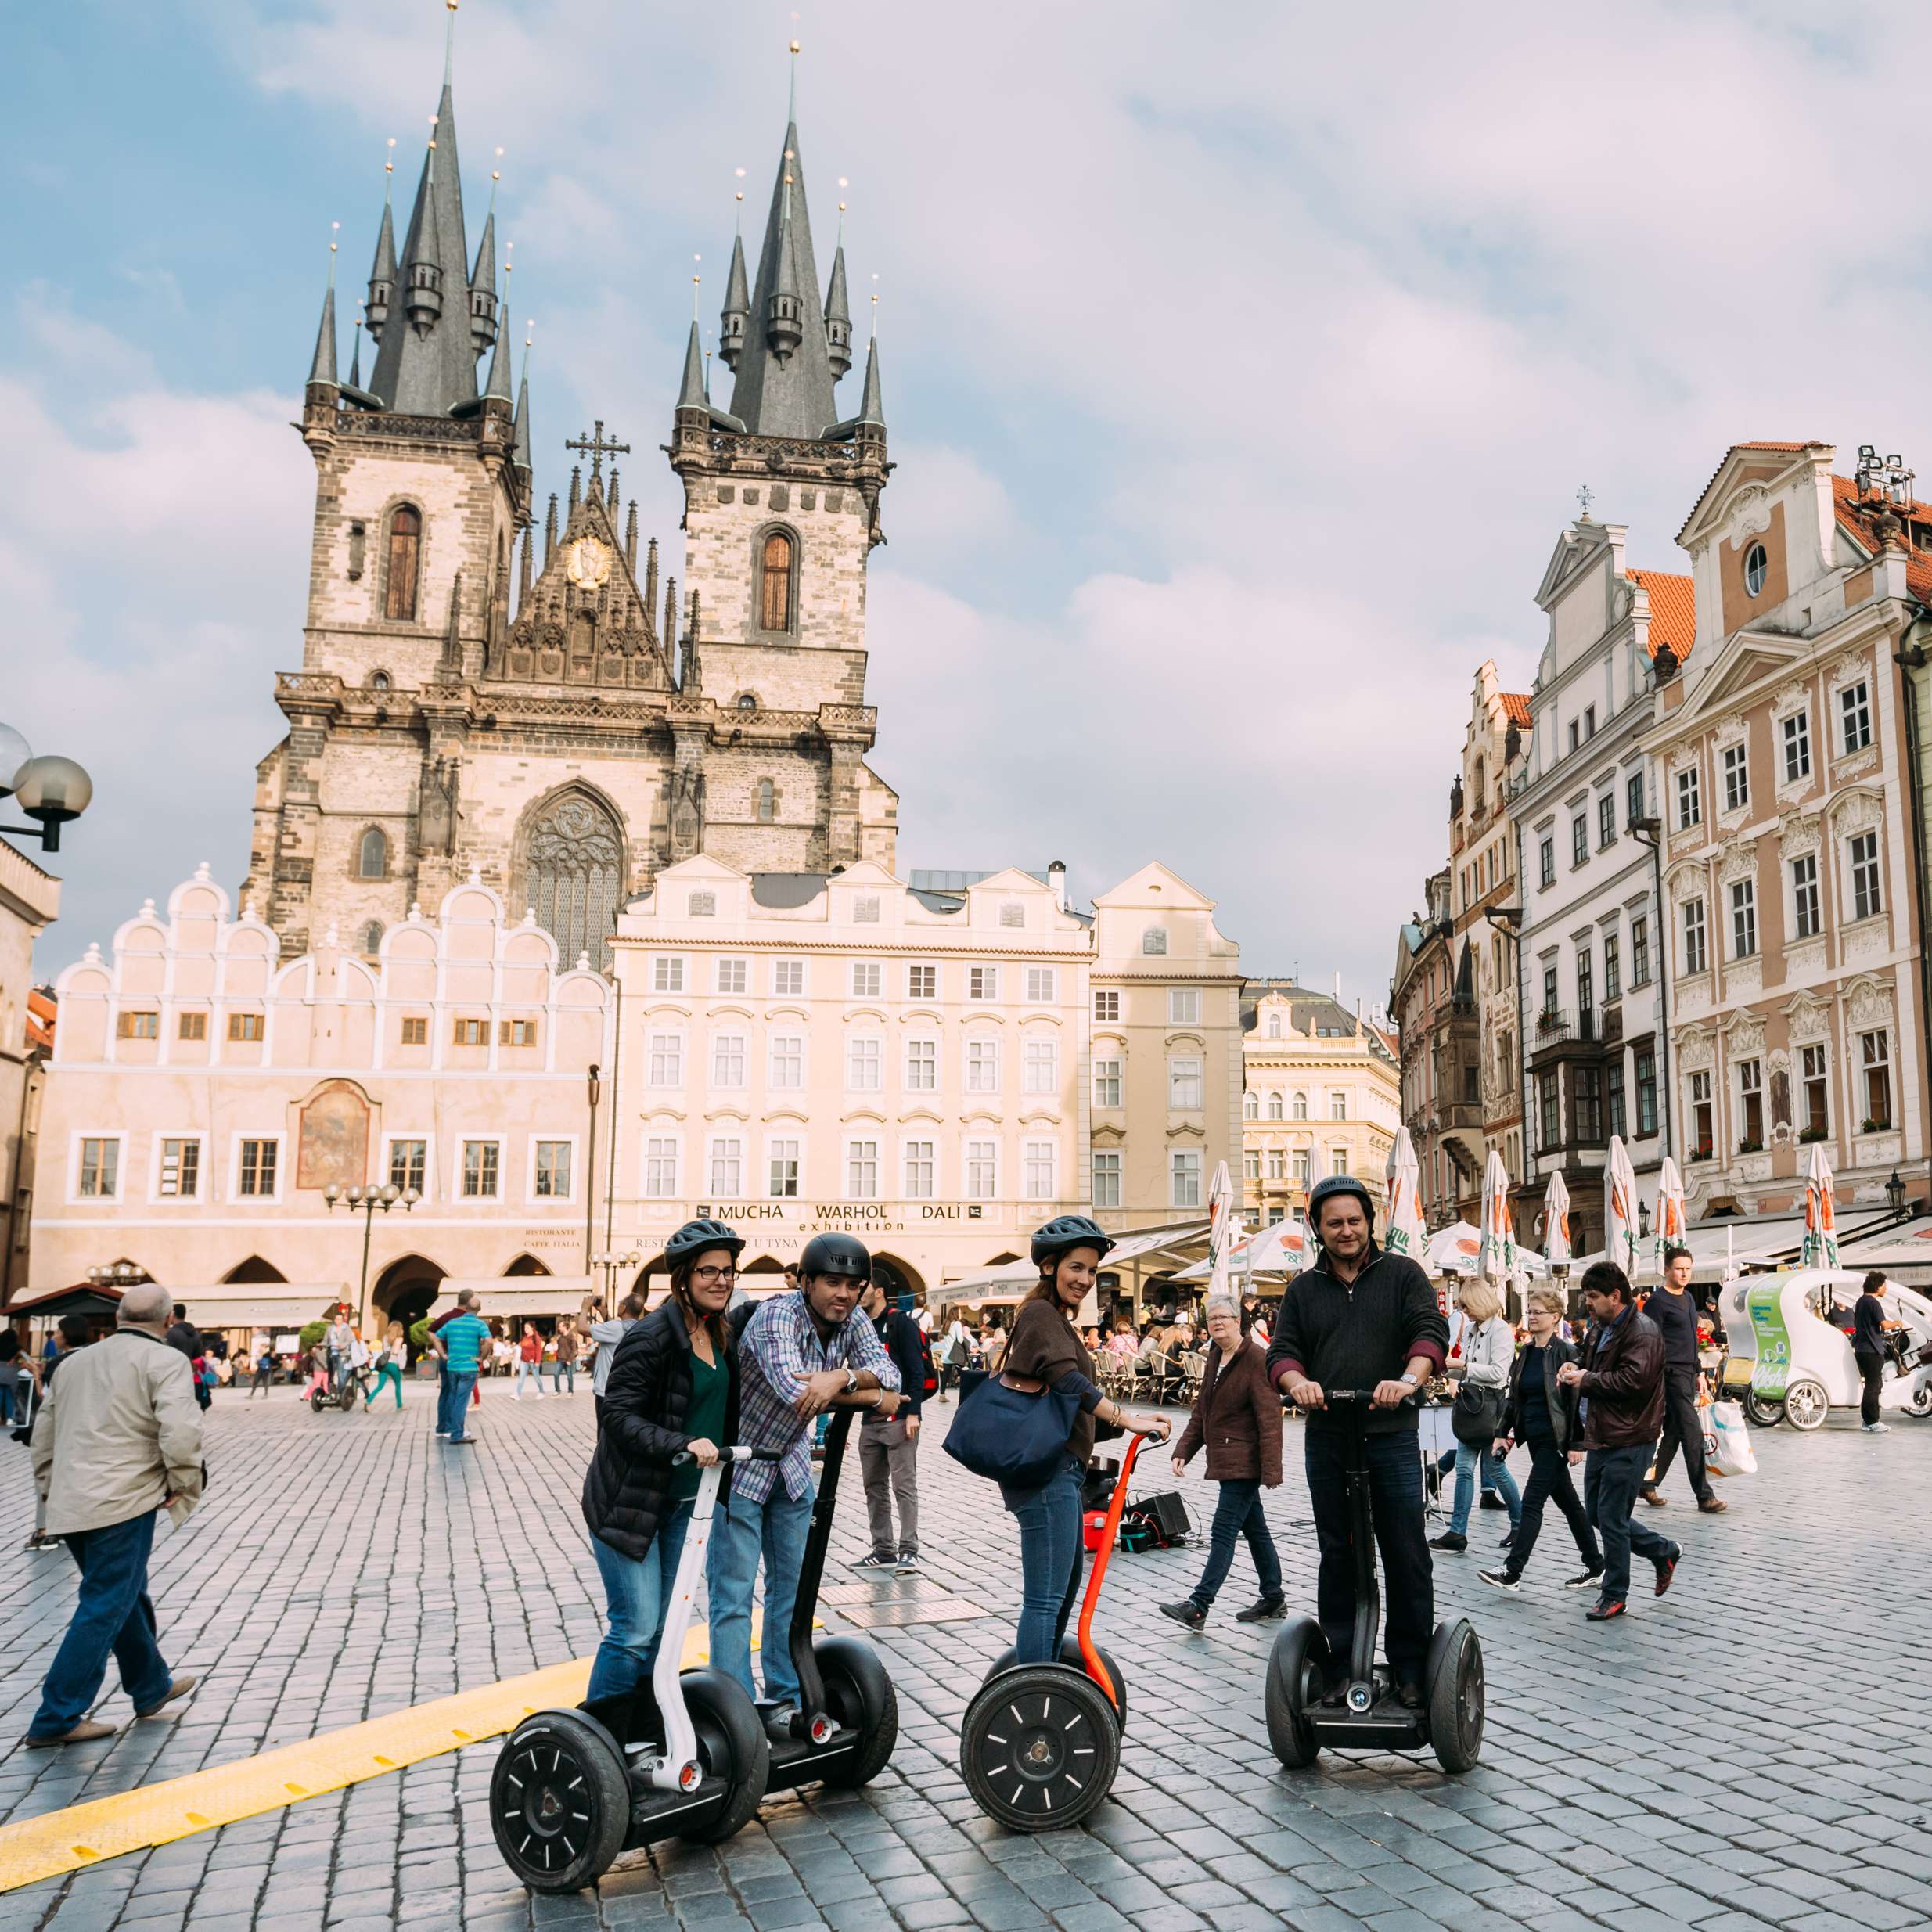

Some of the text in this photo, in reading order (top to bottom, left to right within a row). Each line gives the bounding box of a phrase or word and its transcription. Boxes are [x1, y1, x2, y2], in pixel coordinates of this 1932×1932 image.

[718, 1202, 960, 1219] MUCHA WARHOL DALÍ
[799, 1221, 904, 1231] exhibition
